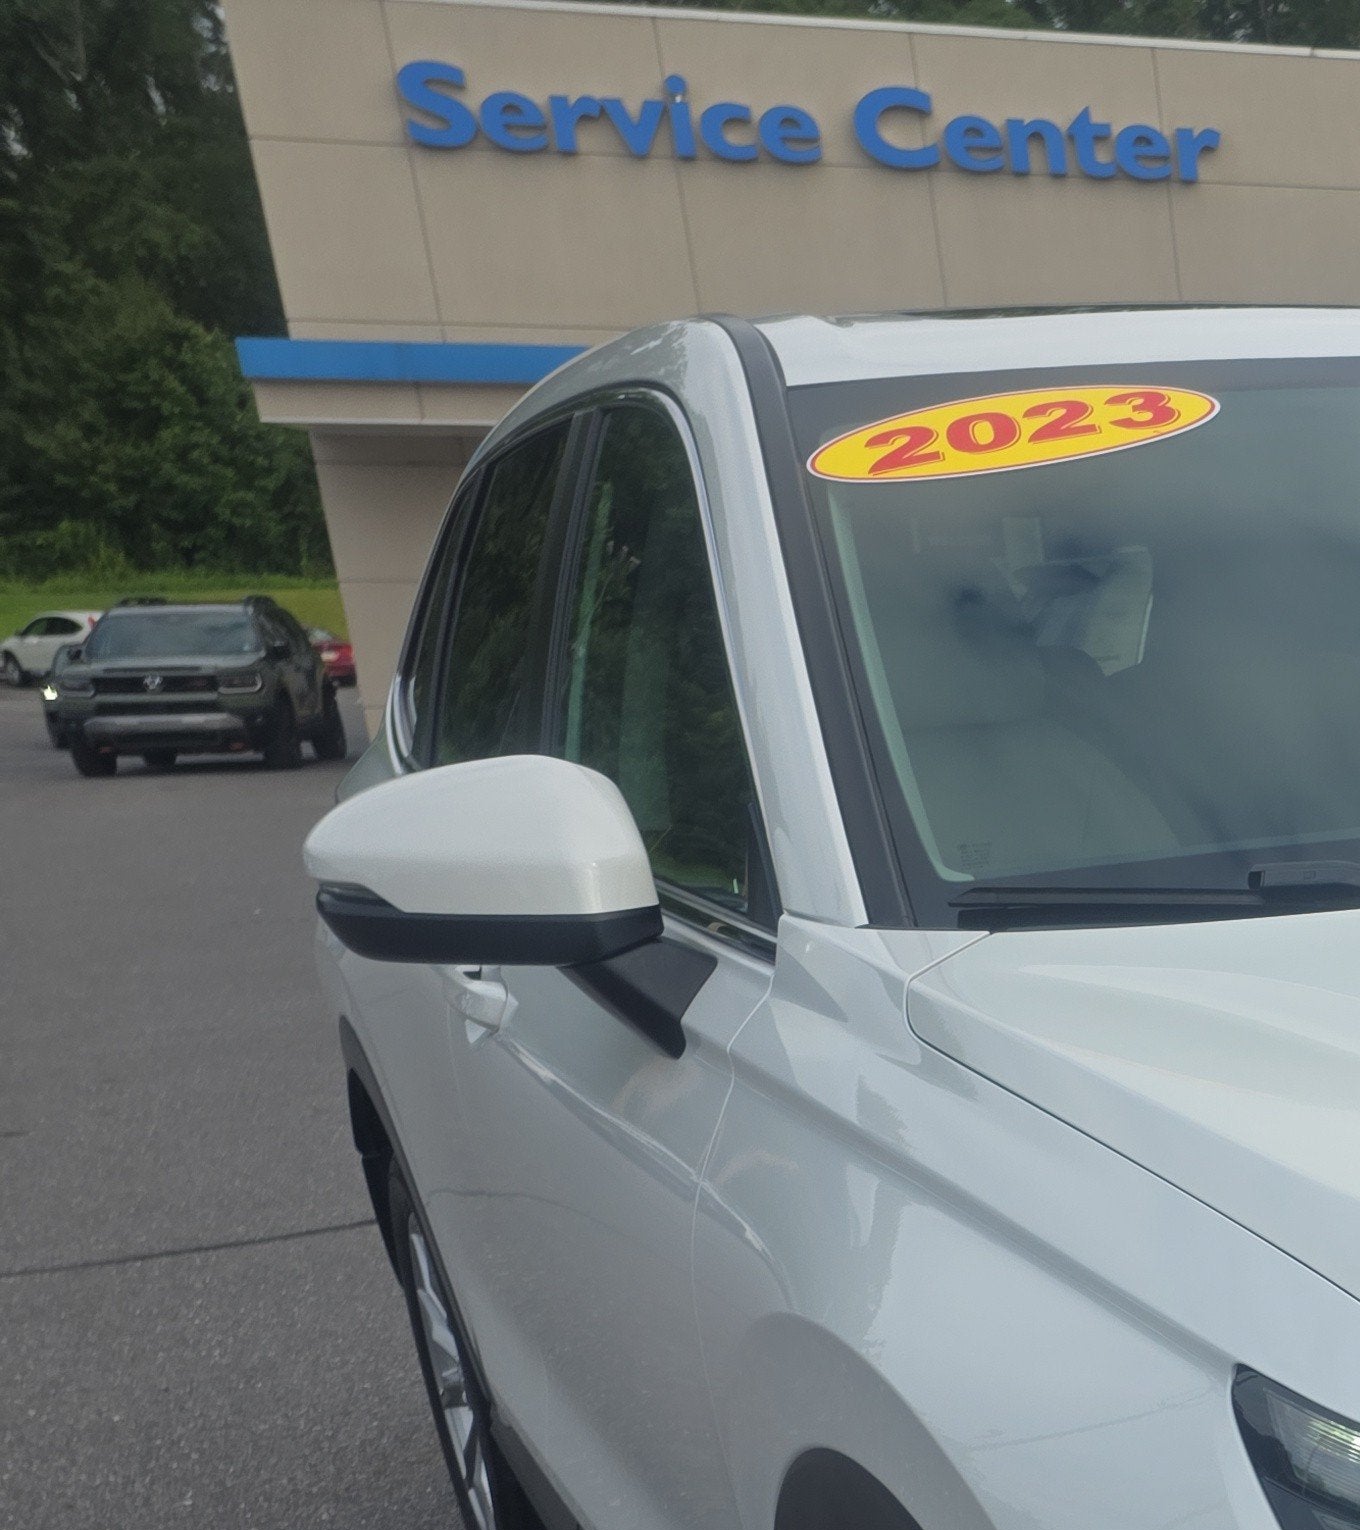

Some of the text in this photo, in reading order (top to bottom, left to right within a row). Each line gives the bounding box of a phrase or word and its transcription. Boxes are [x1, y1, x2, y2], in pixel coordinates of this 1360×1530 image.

[397, 59, 1221, 182] Service Center
[864, 391, 1181, 475] 2023
